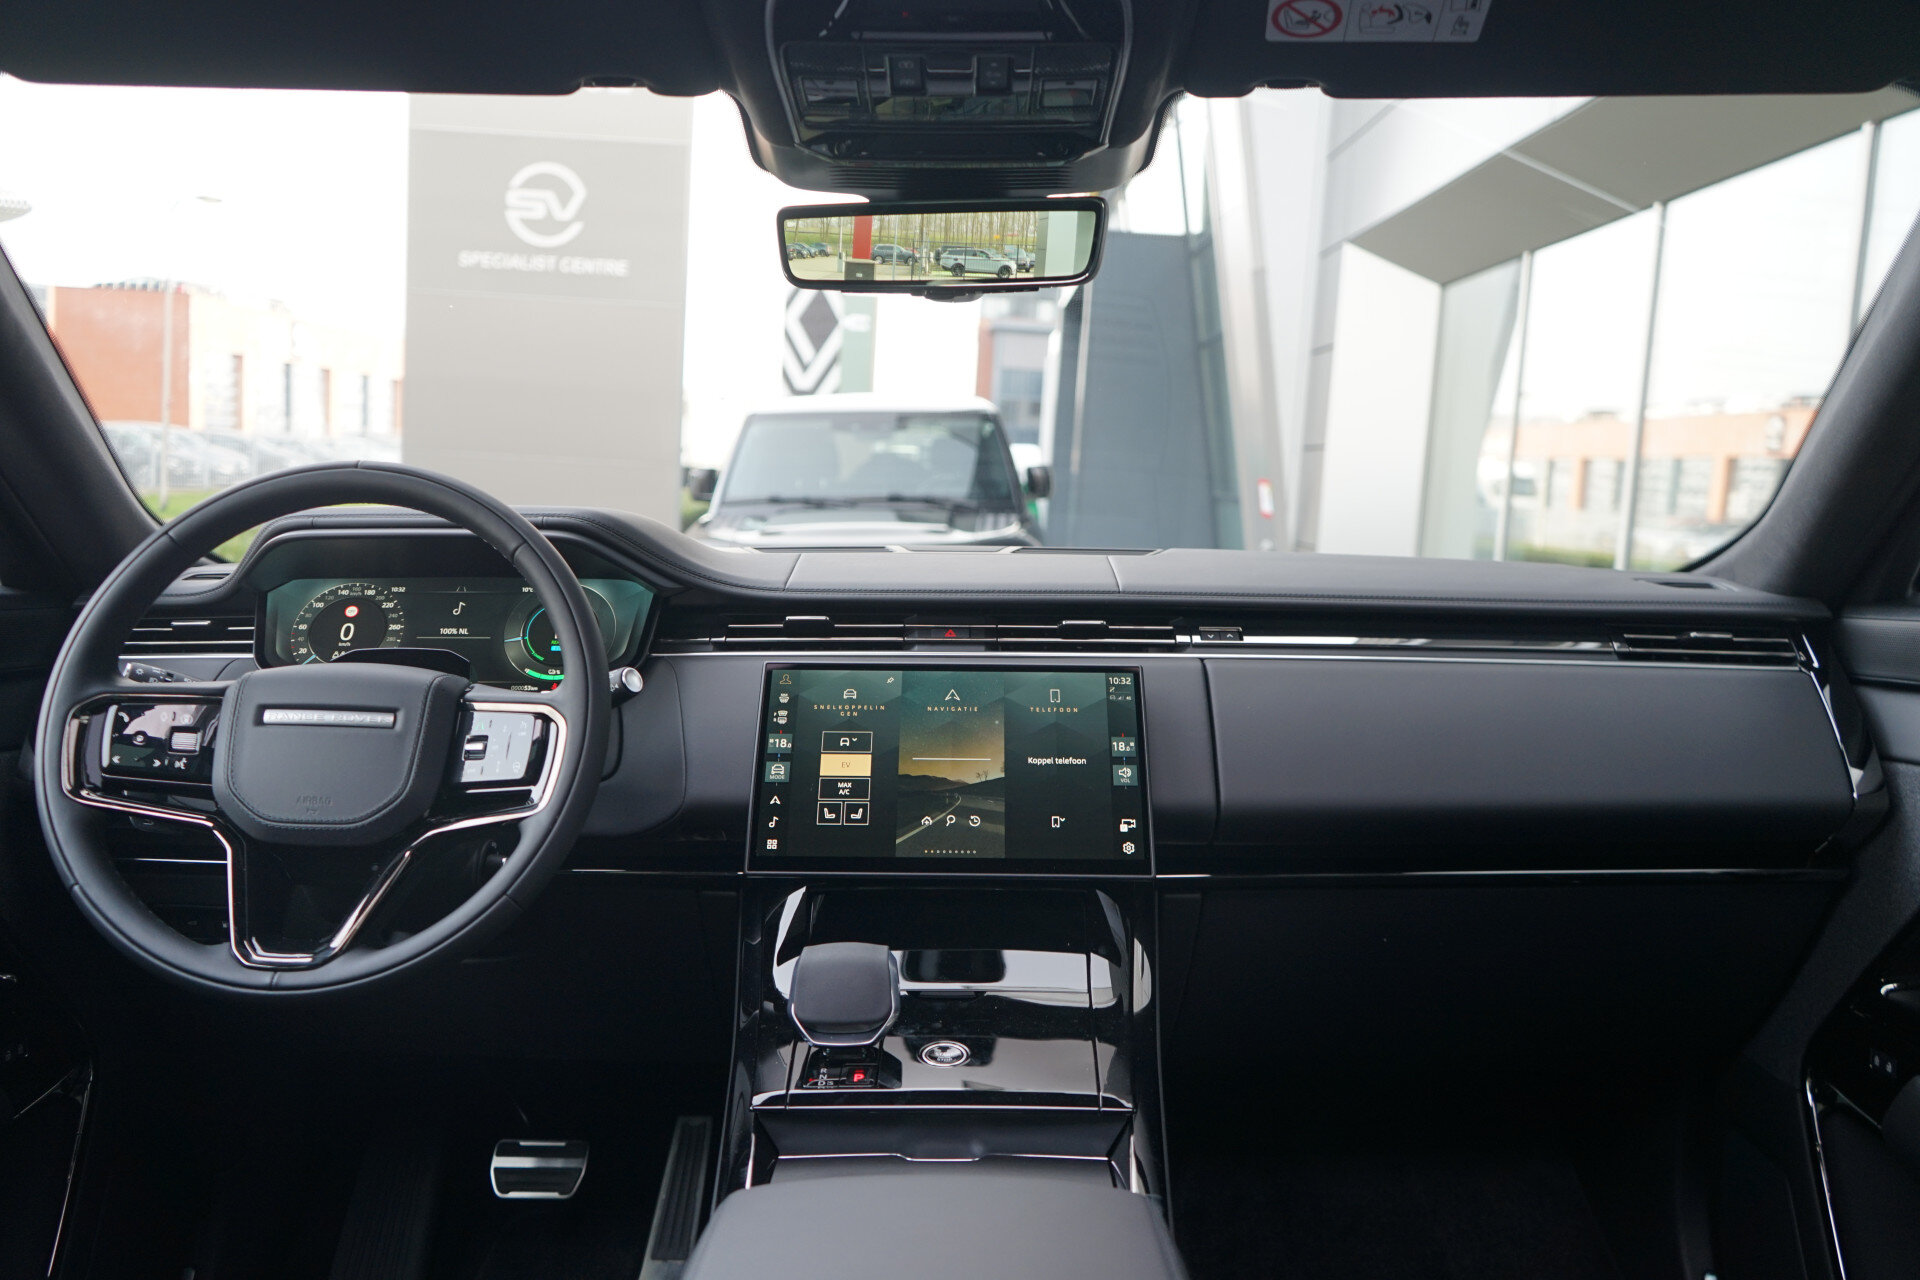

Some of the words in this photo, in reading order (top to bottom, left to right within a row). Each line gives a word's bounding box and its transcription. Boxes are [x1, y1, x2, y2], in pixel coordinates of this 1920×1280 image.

[457, 250, 557, 273] SPECIALIST
[559, 255, 631, 278] CENTRE
[340, 622, 355, 641] 0
[440, 627, 458, 635] 100%
[1108, 677, 1132, 685] 10:32
[267, 711, 326, 721] RANGE
[331, 713, 392, 723] ROVER
[1027, 756, 1054, 765] Koppel
[1055, 756, 1087, 765] telefoon
[853, 1073, 865, 1083] P
